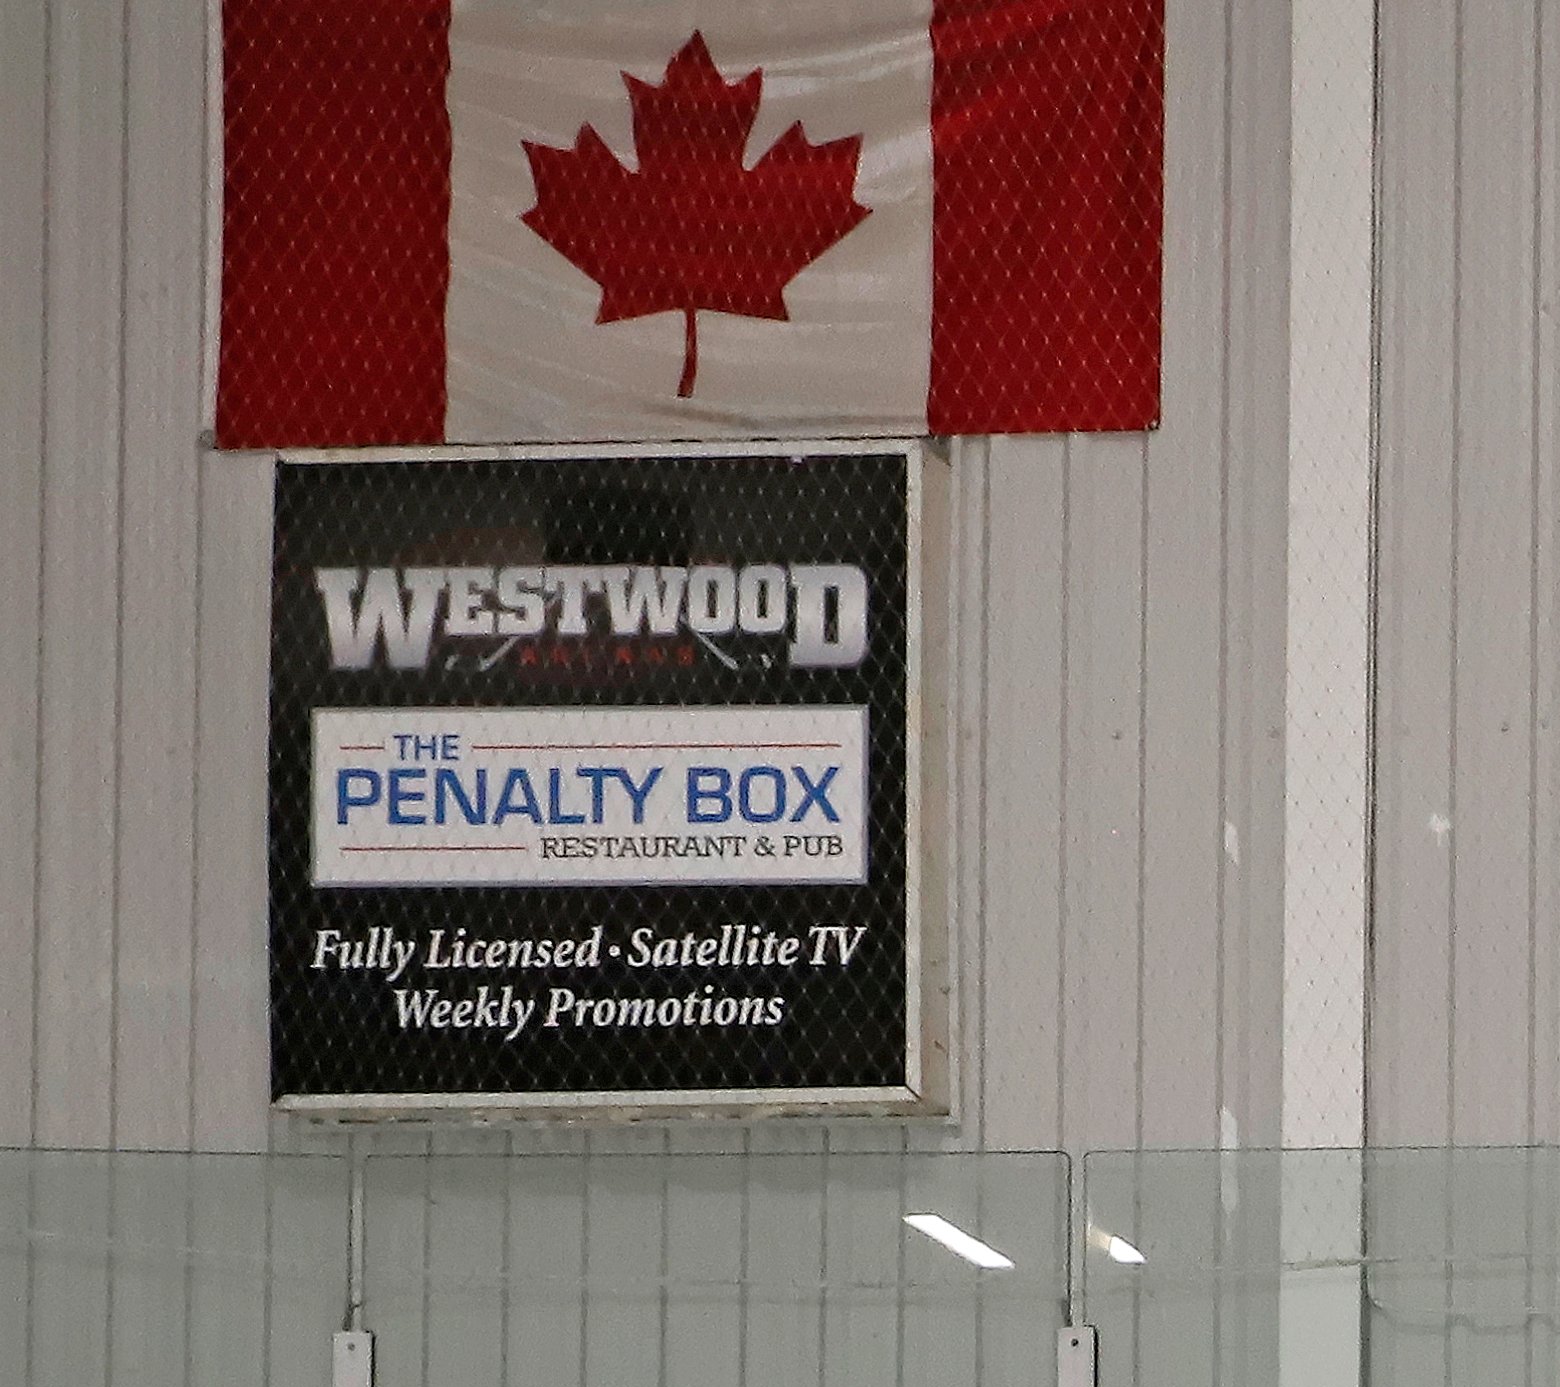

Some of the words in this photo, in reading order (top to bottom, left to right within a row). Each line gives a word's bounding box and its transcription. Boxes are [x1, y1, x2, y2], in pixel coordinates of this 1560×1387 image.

[312, 565, 868, 670] WESTWOOD
[393, 735, 459, 760] THE
[337, 767, 663, 825] PENALTY
[686, 765, 840, 824] BOX
[540, 836, 746, 860] RESTAURANT
[755, 836, 777, 858] &
[783, 835, 843, 858] PUB
[311, 929, 416, 982] Fully
[423, 928, 601, 969] Licensed
[627, 924, 799, 968] Satellite
[807, 926, 866, 963] TV
[392, 990, 533, 1042] Weekly
[543, 986, 784, 1029] Promotions
